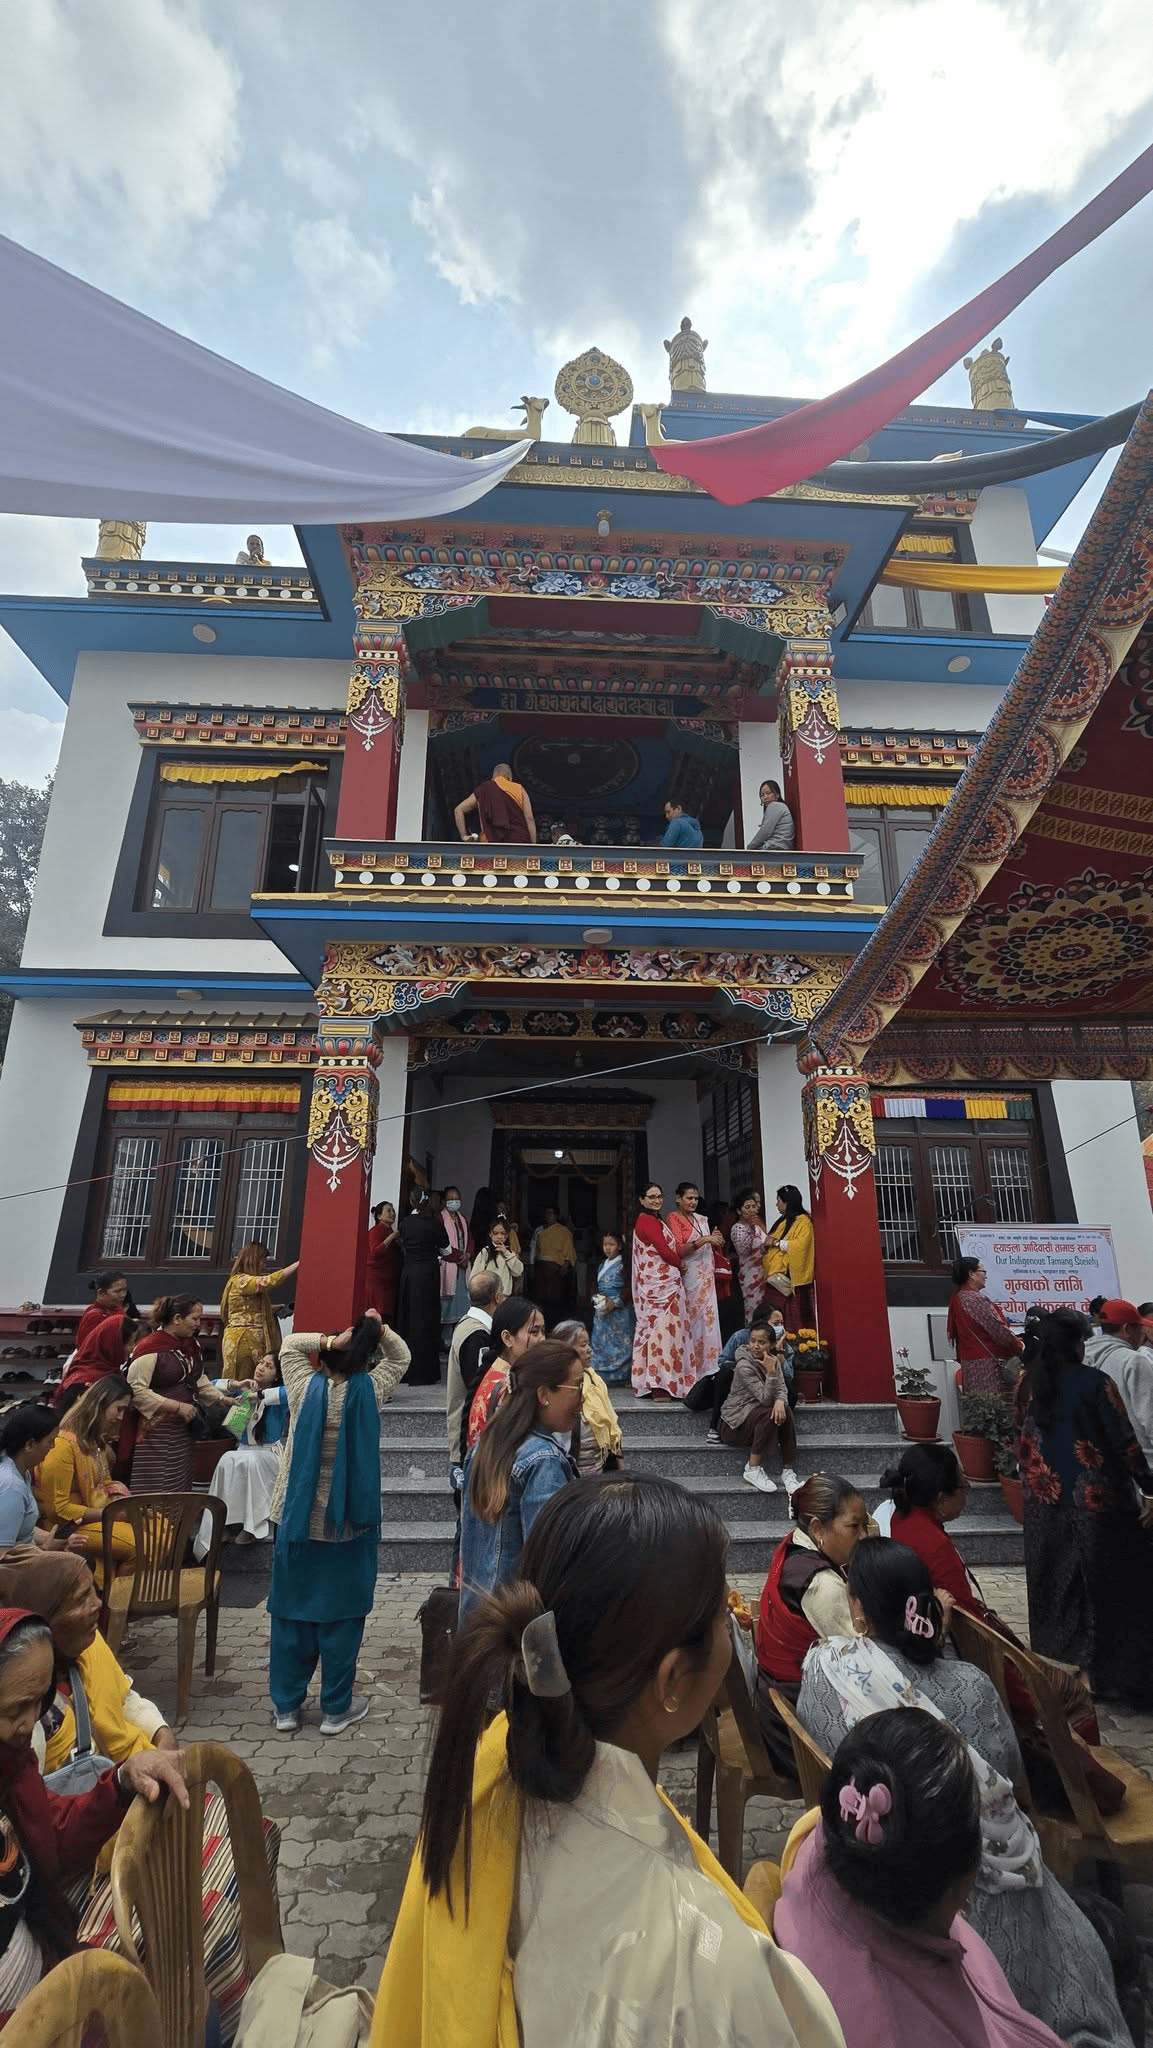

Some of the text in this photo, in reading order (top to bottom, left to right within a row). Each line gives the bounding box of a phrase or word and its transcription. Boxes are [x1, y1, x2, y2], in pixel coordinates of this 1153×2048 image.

[1022, 1241, 1053, 1253] आदिवासी
[1076, 1244, 1097, 1253] समाज
[995, 1255, 1099, 1268] Our Indigenous Tamang Society
[1003, 1275, 1084, 1295] गुम्बाको लागि
[995, 1298, 1027, 1314] हयोग
